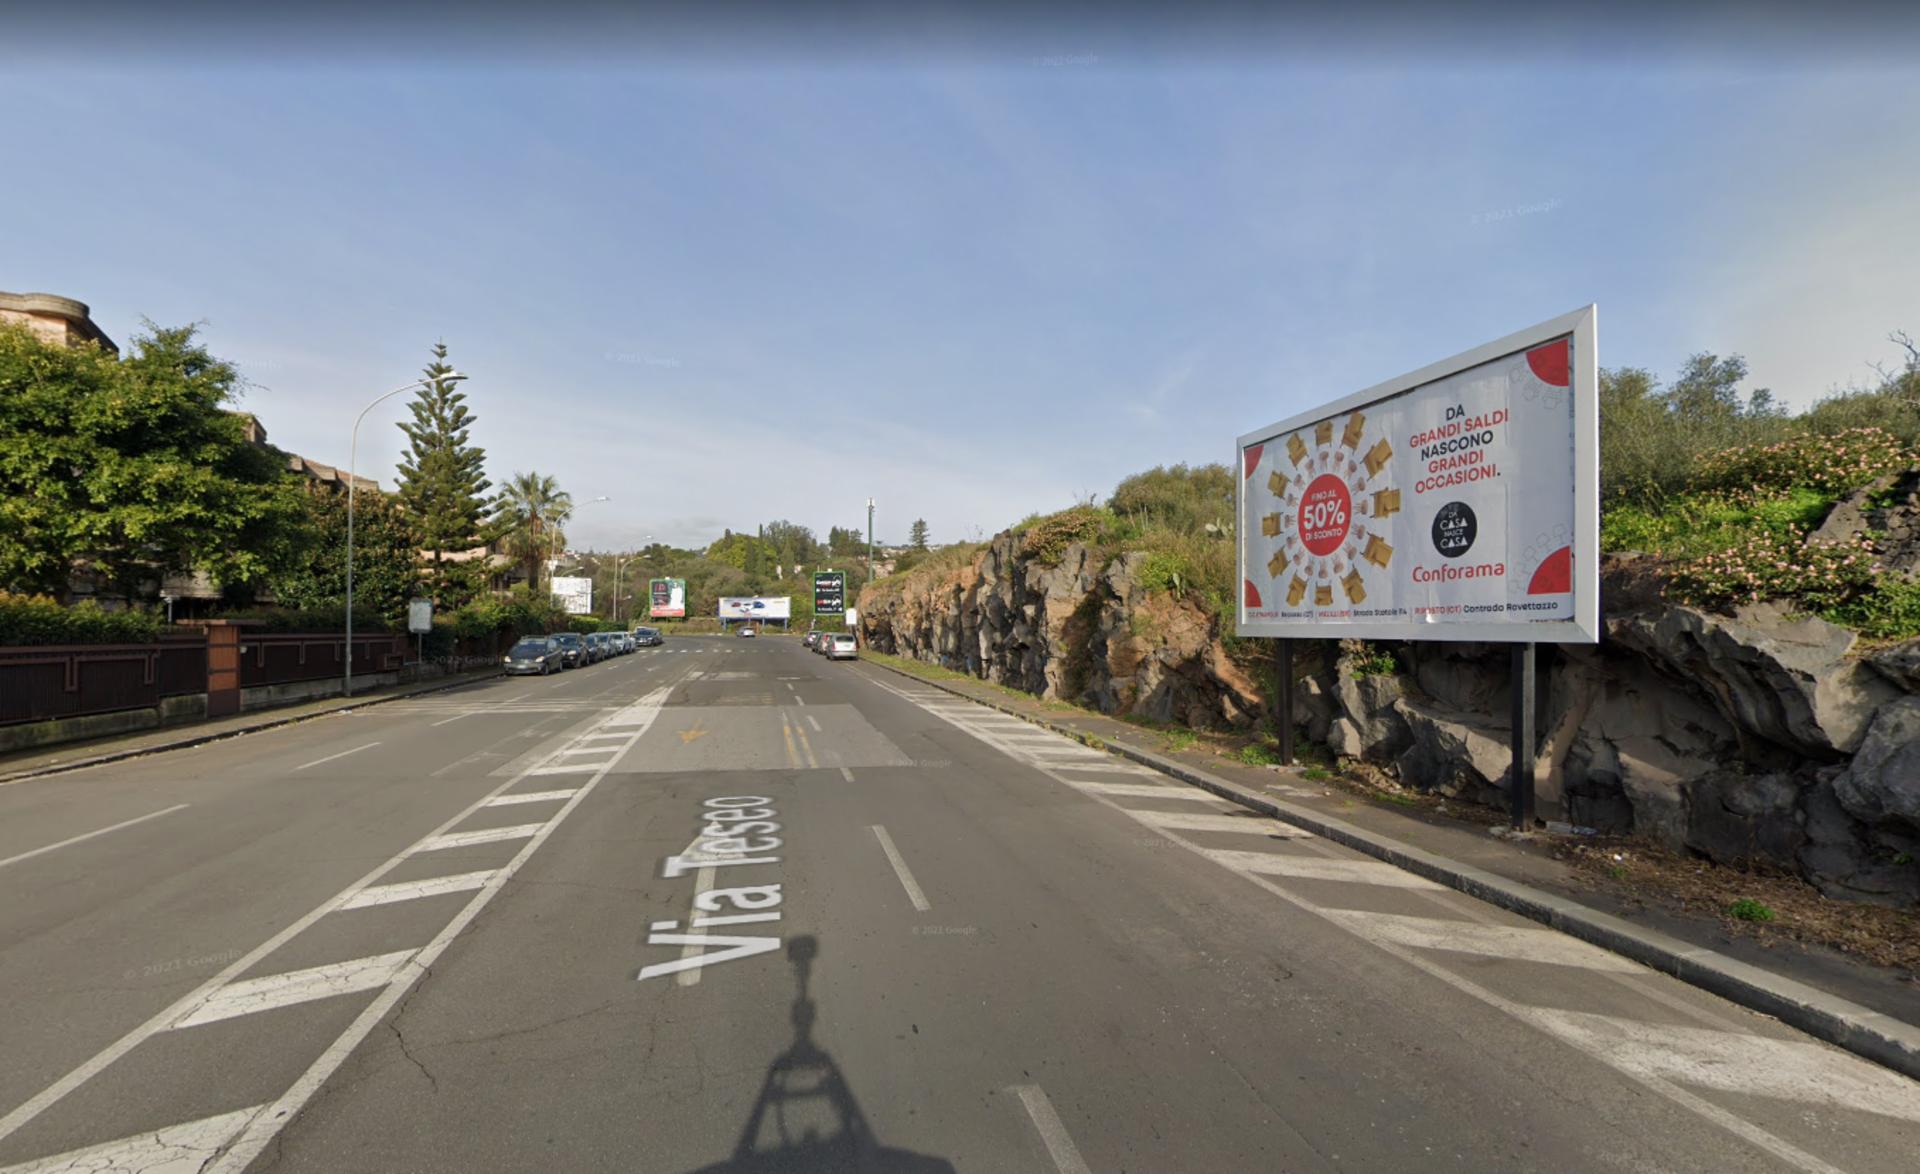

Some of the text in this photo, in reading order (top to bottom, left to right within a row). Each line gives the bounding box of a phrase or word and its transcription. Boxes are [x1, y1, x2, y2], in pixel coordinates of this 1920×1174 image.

[1446, 404, 1465, 421] DA
[1409, 407, 1508, 449] GRANDI SALDI
[1421, 430, 1494, 461] NASCONO
[1428, 449, 1484, 474] GRANDI
[1415, 463, 1501, 494] OCCASIONI.
[1303, 499, 1345, 530] 50%
[1440, 517, 1468, 530] CASA
[1313, 528, 1342, 539] SCONTO
[1440, 536, 1468, 549] CASA
[1412, 562, 1505, 583] Conforama
[1463, 603, 1505, 613] Contrada
[1506, 602, 1558, 612] Rovettazzo
